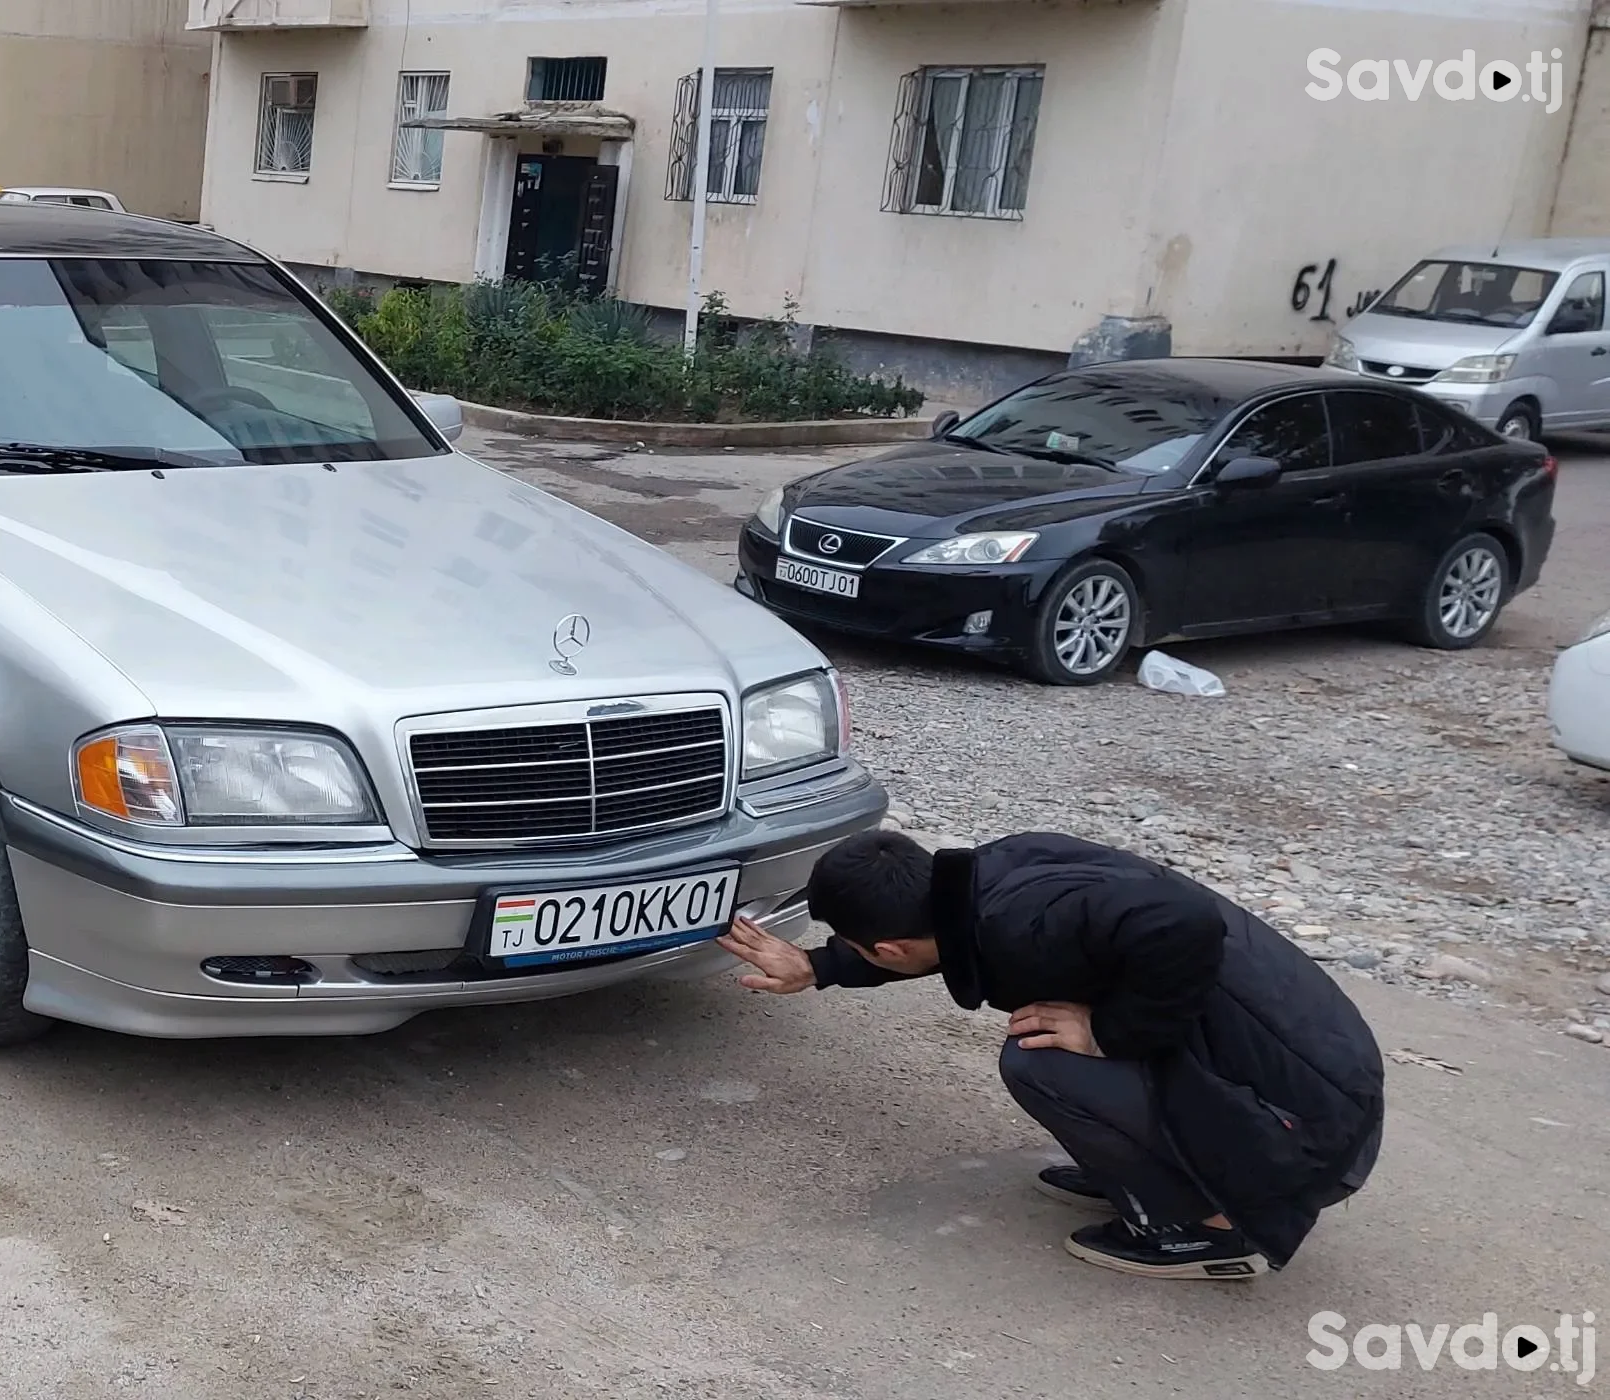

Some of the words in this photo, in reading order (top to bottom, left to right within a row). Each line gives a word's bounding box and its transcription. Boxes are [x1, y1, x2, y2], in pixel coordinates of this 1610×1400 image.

[1292, 258, 1337, 325] 61
[787, 563, 855, 595] 0600TJ01
[533, 876, 728, 946] 0210KK01
[501, 928, 525, 949] TJ
[551, 951, 583, 962] MOTOR
